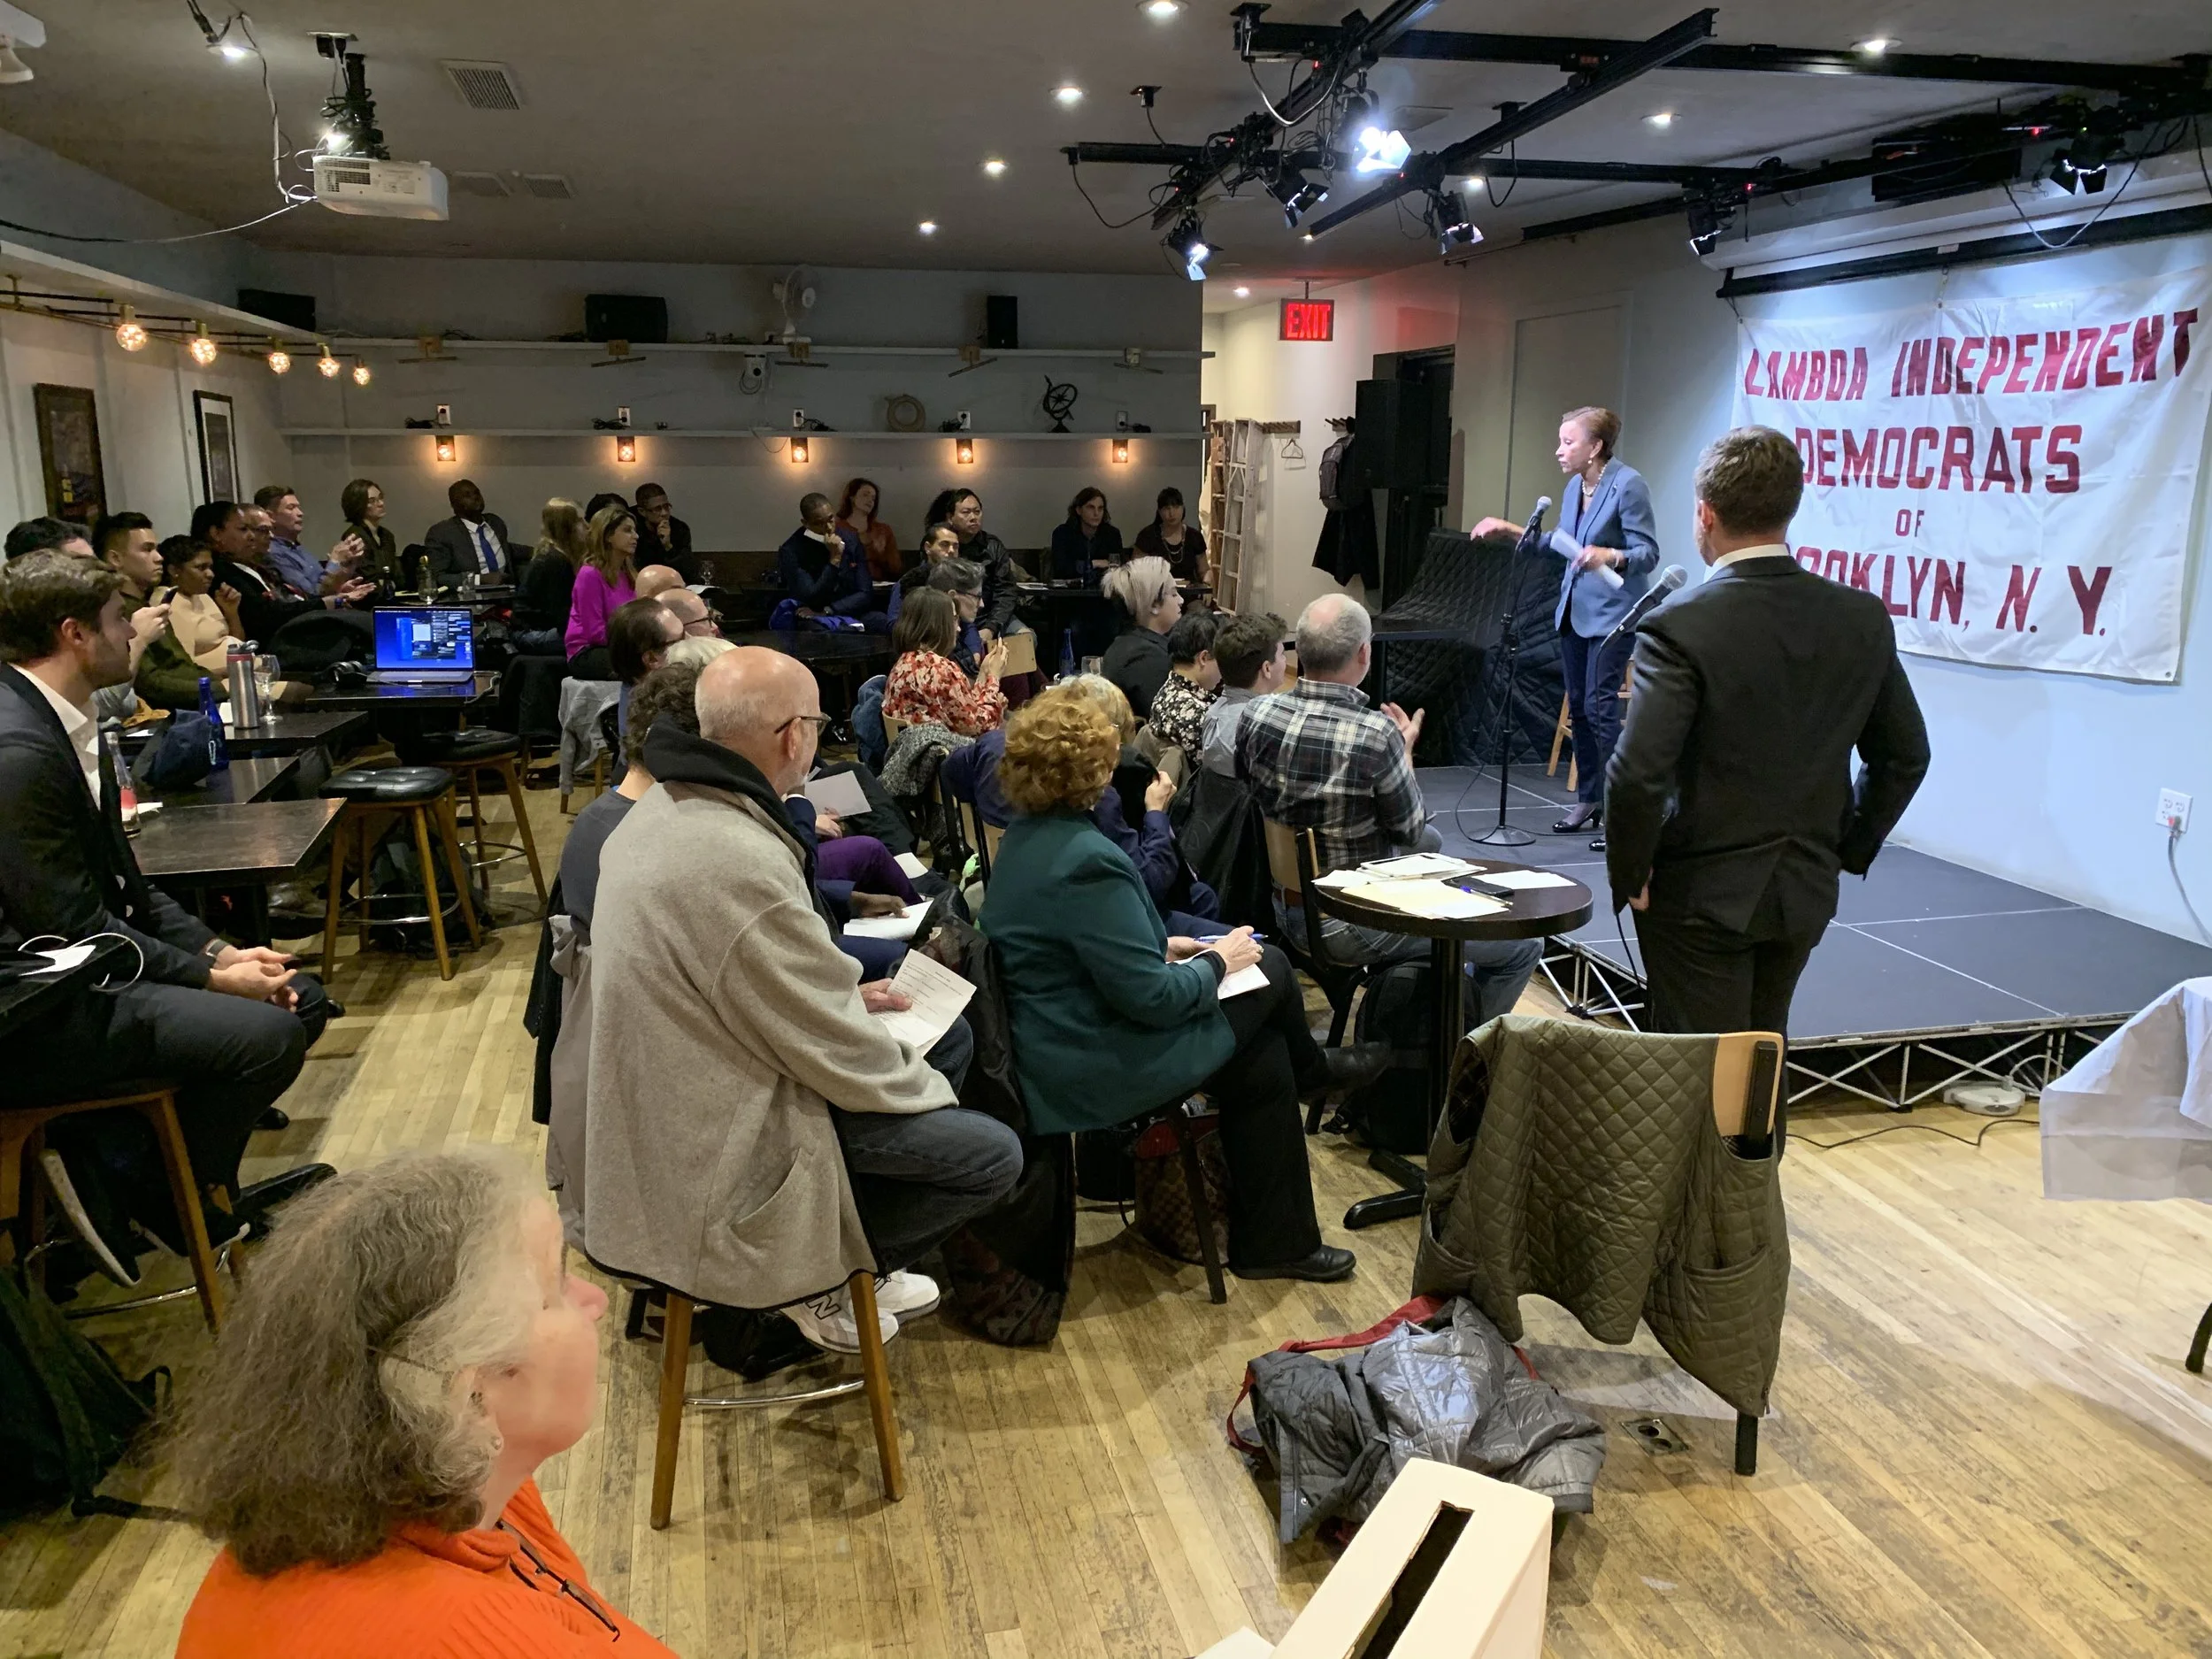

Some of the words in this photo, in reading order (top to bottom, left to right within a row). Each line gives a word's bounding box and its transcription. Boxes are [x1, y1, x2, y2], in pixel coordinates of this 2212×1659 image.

[1286, 303, 1331, 339] EXIT
[1745, 347, 1869, 401] LAMBDA
[1891, 308, 2199, 396] INDEPENDENT
[1795, 425, 2083, 494] DEMOCRATS
[1895, 509, 1925, 538] OF
[1995, 565, 2040, 634] N.
[2067, 565, 2112, 636] Y.
